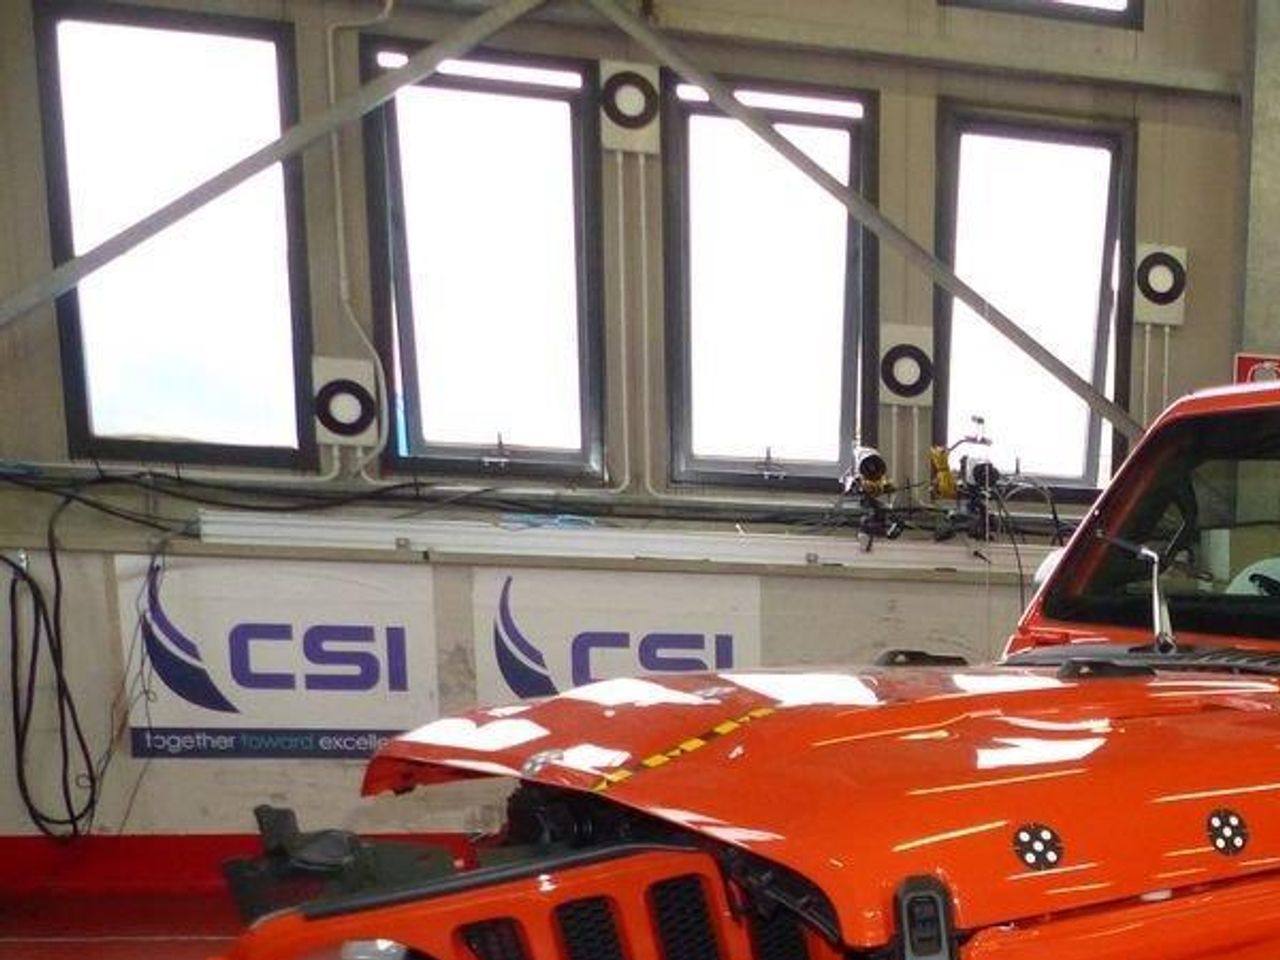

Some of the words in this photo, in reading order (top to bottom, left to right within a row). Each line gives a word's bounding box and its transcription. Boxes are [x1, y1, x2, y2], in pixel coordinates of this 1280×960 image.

[228, 622, 408, 692] CSI
[145, 731, 235, 754] together
[240, 732, 313, 750] toward
